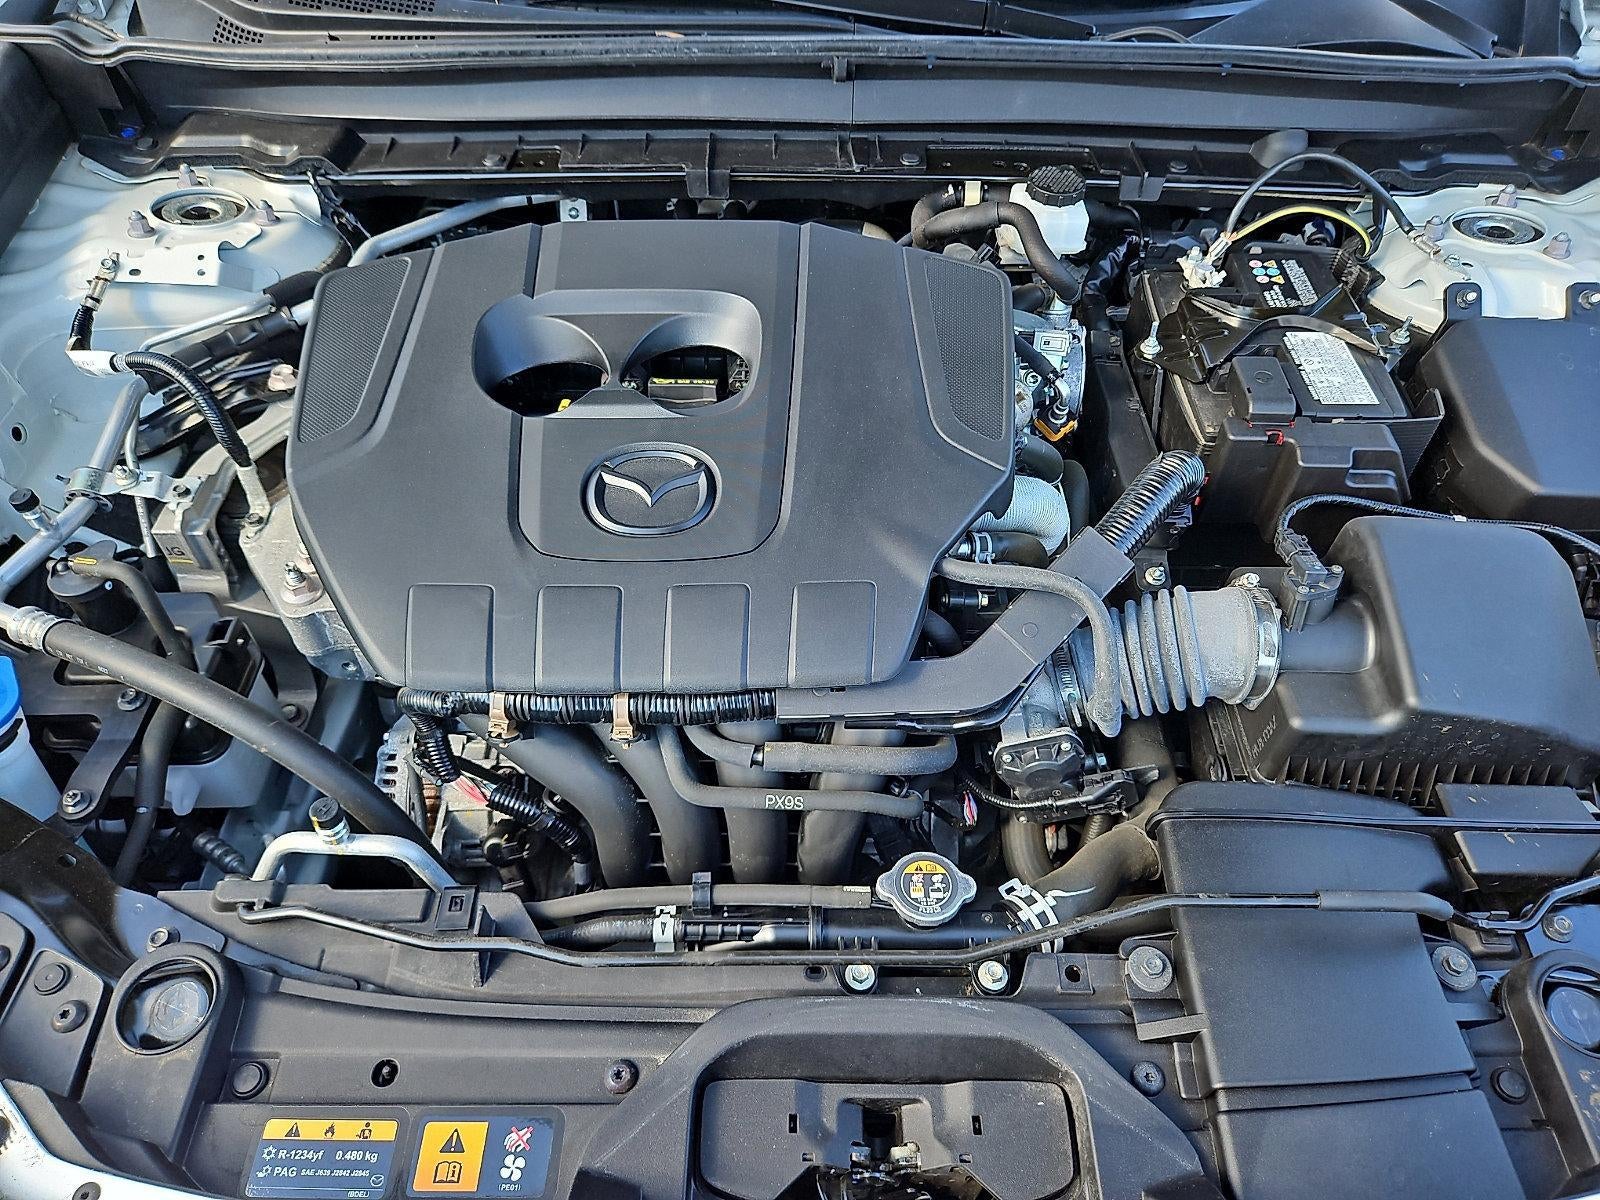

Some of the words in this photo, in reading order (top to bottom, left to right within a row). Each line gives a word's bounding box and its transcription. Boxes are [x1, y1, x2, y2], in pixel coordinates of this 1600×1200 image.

[765, 794, 804, 810] PX9S
[277, 1149, 324, 1162] R-1234yf
[335, 1150, 363, 1161] 0.480
[364, 1150, 379, 1163] kg
[273, 1166, 298, 1177] PAG
